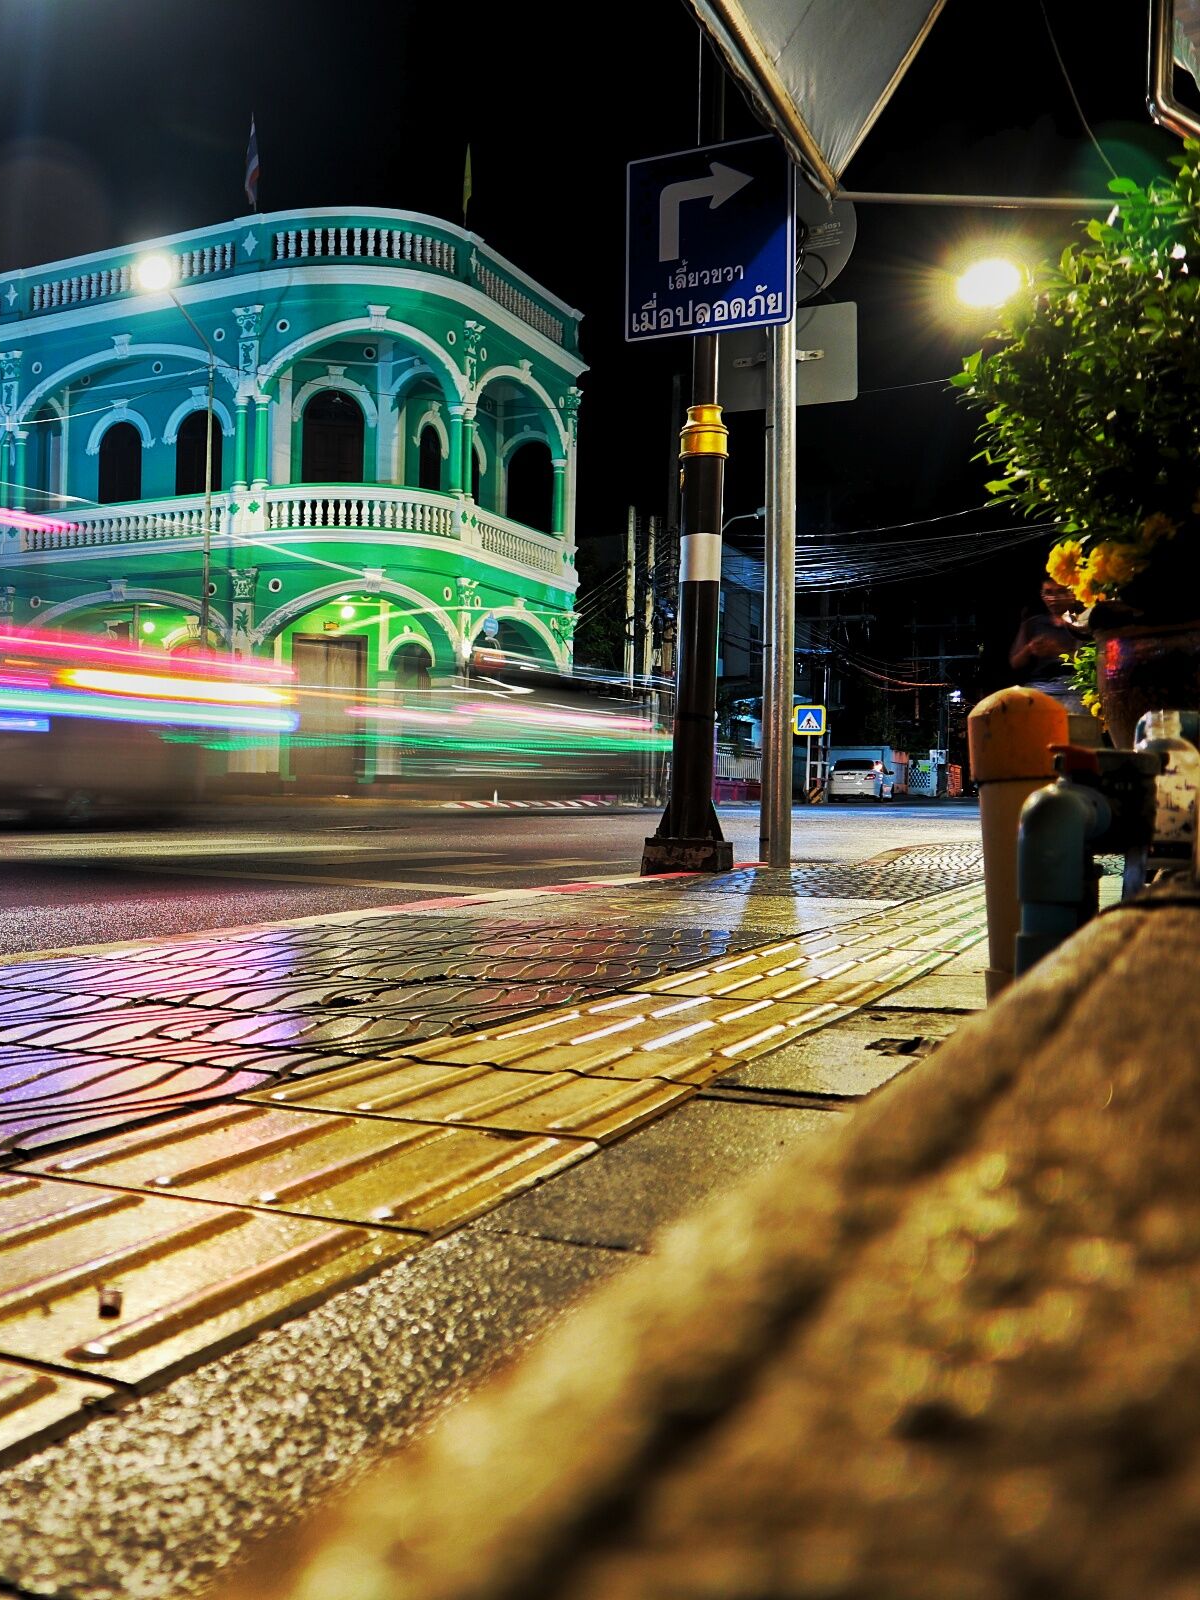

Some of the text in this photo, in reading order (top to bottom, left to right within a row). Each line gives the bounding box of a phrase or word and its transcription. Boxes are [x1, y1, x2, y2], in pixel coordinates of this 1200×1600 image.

[668, 260, 745, 292] เลี้ยวขวา
[631, 284, 784, 333] เมื่อปลอดภัย
